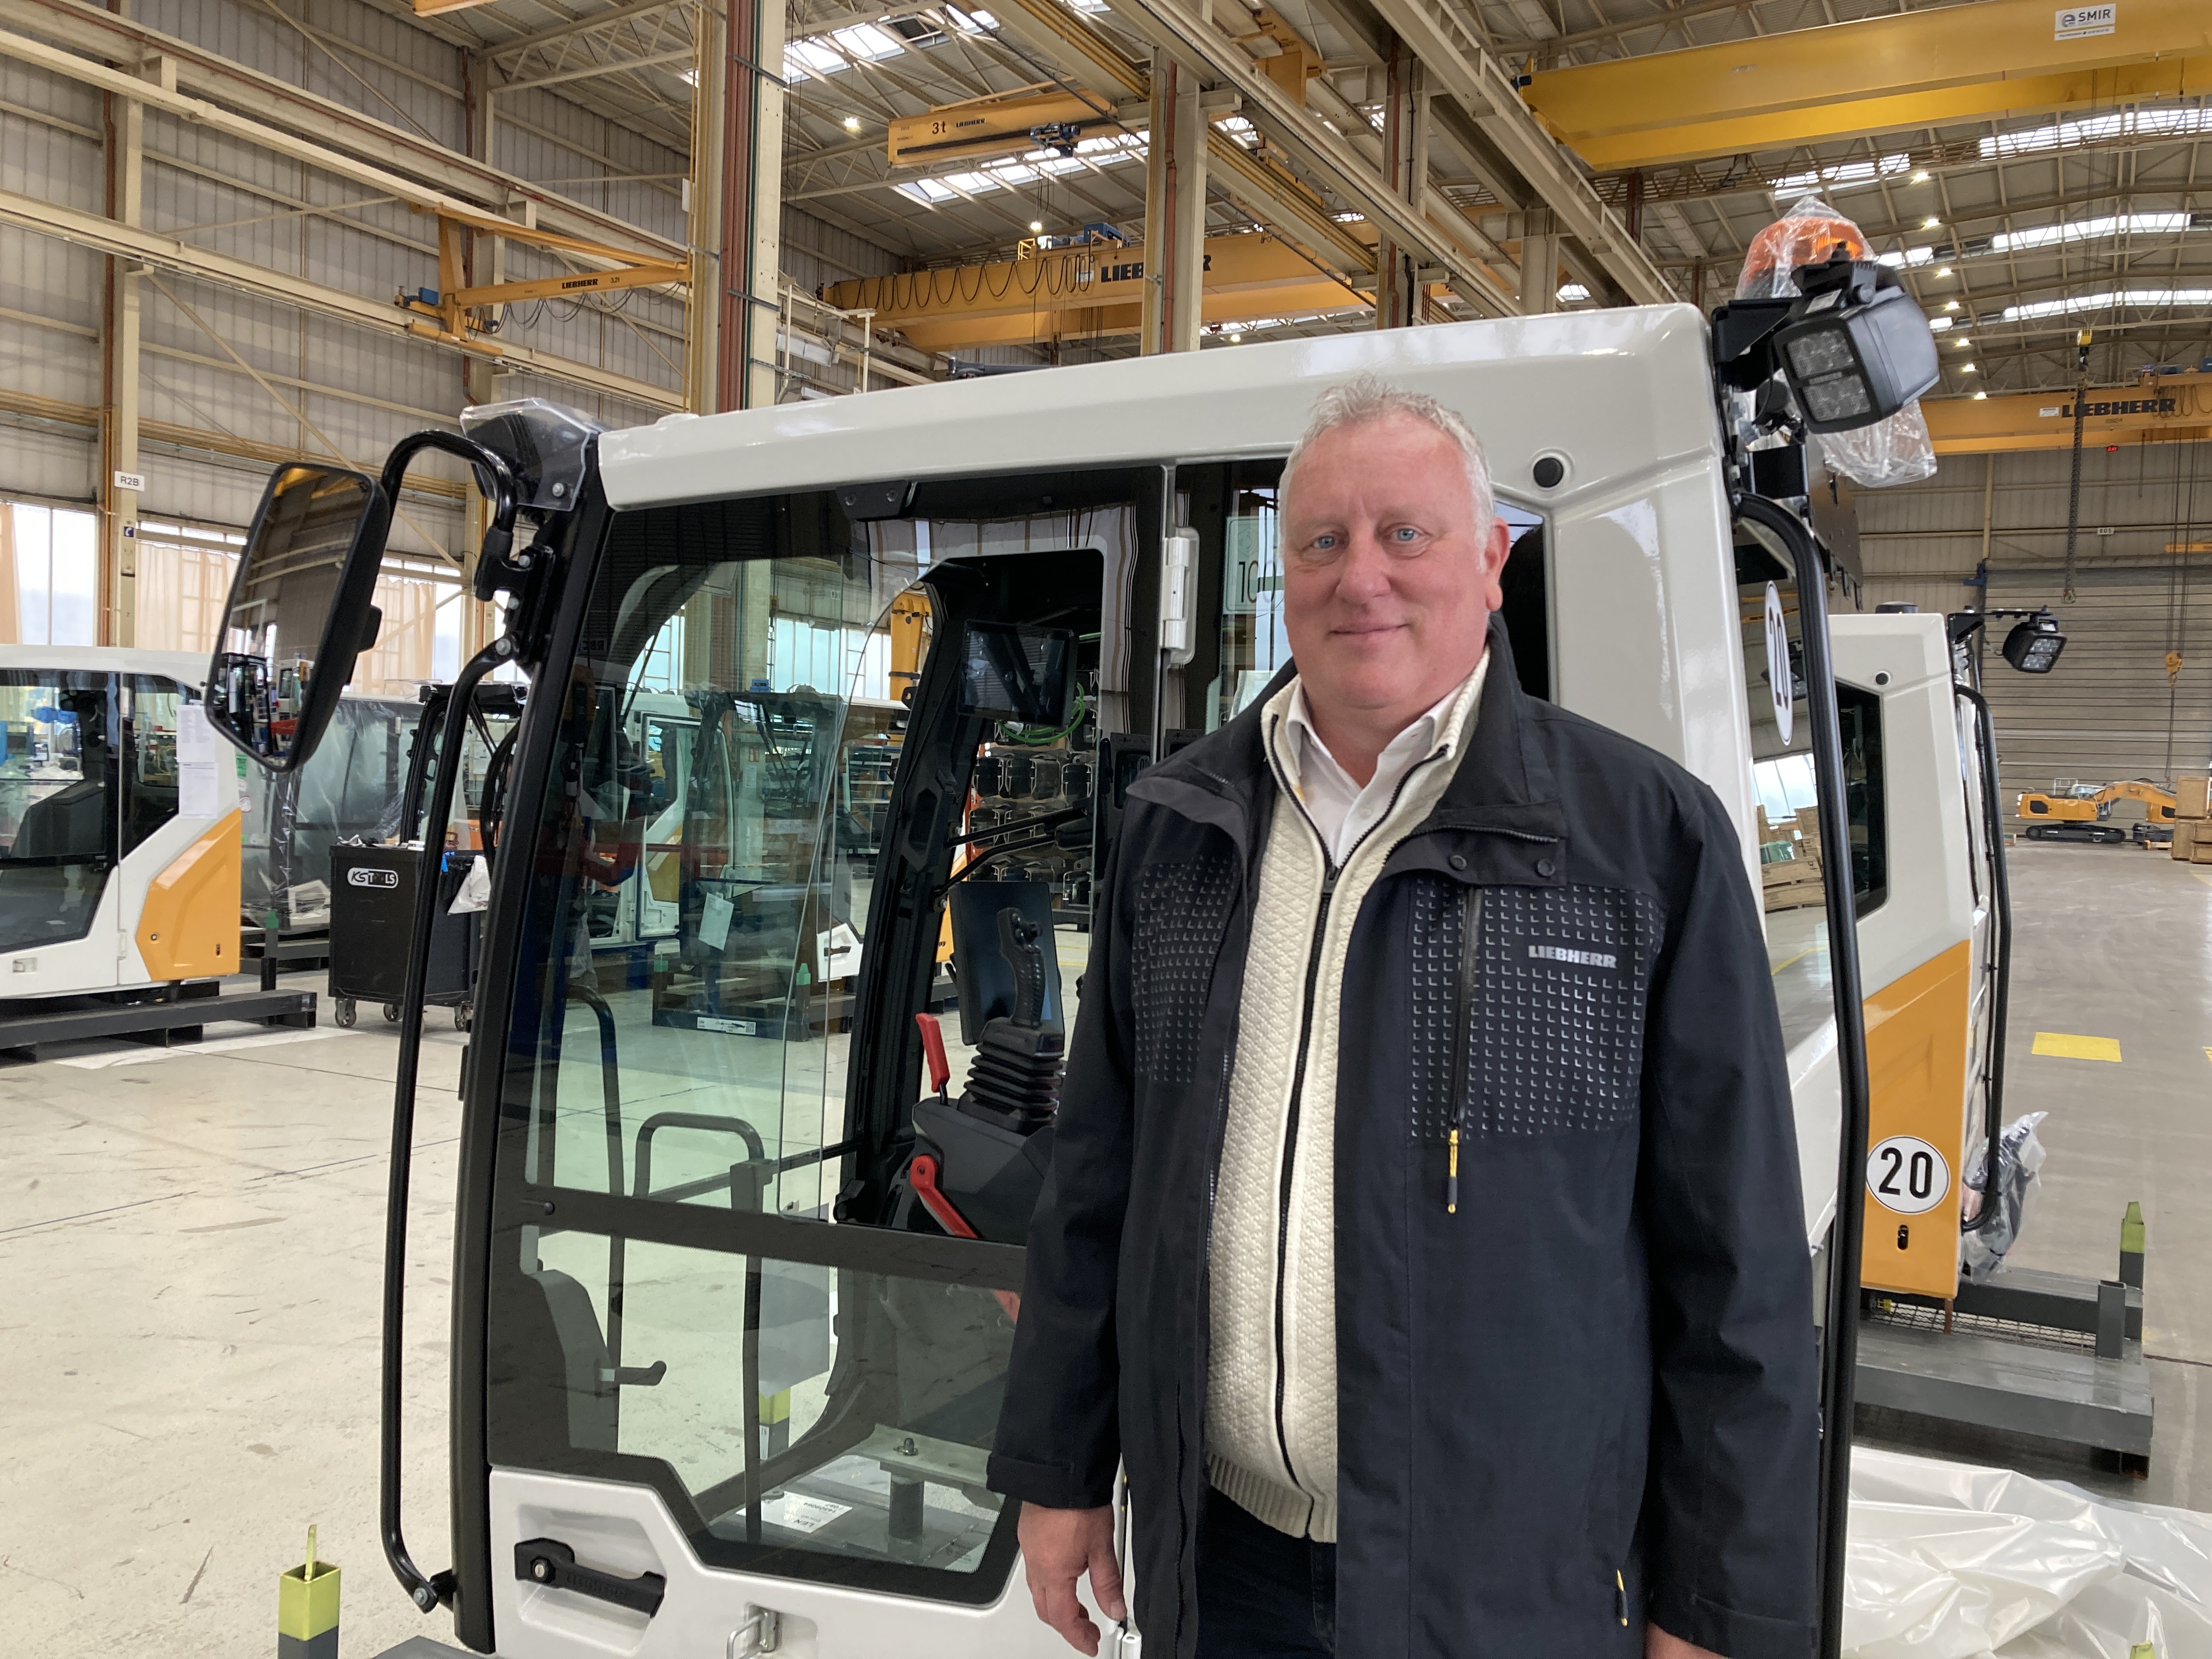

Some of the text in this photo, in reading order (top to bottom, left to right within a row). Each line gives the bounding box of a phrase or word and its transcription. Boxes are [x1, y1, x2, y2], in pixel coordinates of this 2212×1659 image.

[2078, 9, 2111, 22] SMIR
[1101, 254, 1211, 283] LIEBR
[562, 278, 598, 289] LIEBHERR
[2062, 398, 2176, 418] LEBHERR
[120, 476, 139, 486] R2B
[1769, 606, 1789, 710] 20
[368, 872, 395, 884] TLS
[1528, 945, 1617, 969] LIEBHERR
[1879, 1147, 1933, 1199] 20
